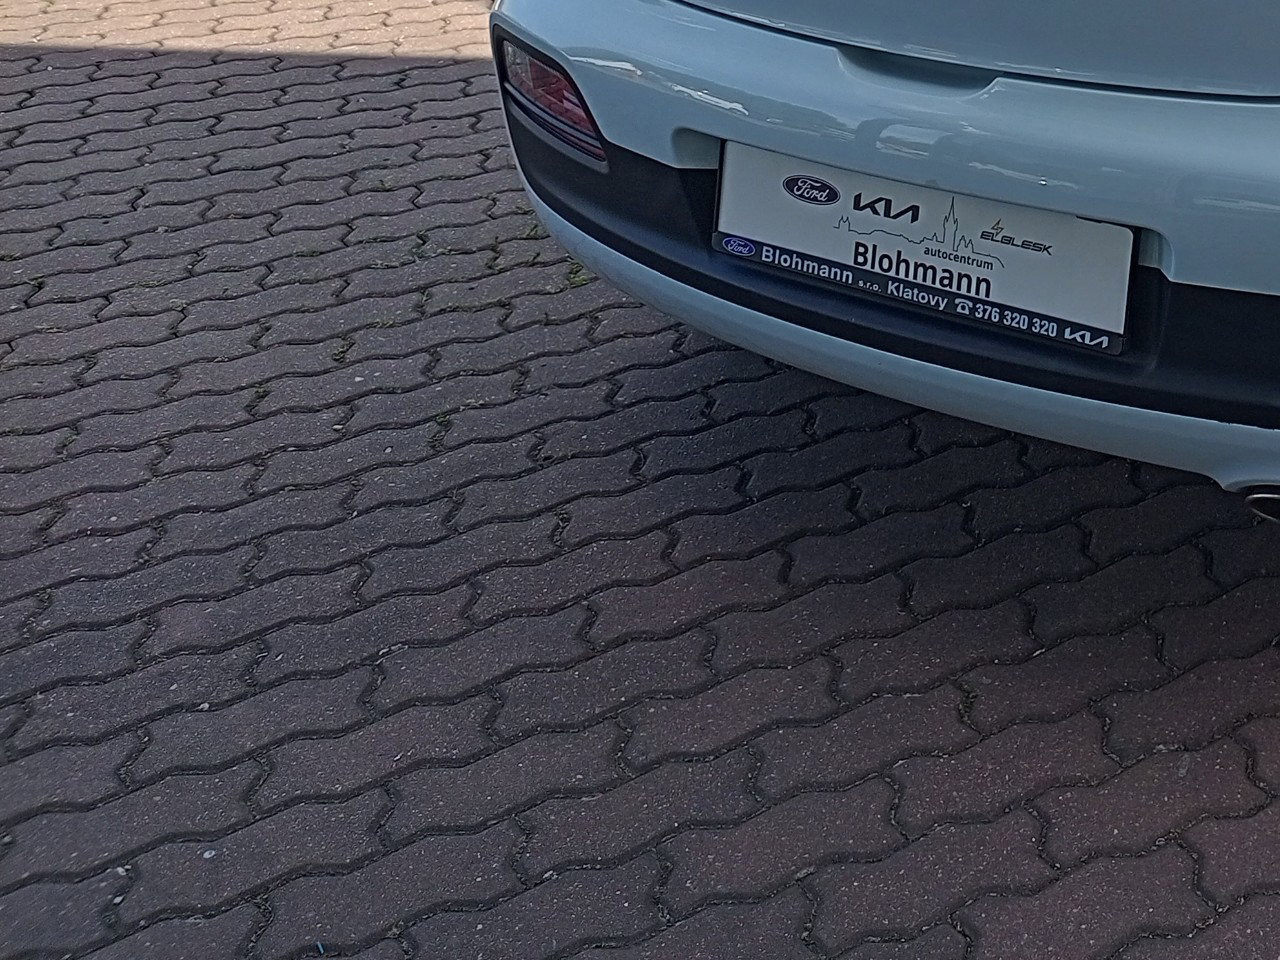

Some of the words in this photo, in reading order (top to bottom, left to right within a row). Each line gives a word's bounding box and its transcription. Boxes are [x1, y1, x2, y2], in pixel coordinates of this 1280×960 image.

[793, 178, 830, 202] Ford
[853, 192, 919, 224] KIA
[924, 245, 994, 271] autocentrum
[980, 229, 1053, 256] ELBLESK
[761, 246, 853, 284] Blohmann
[858, 280, 882, 292] s.r.o.
[887, 280, 948, 311] Klatovy
[975, 303, 1000, 323] 376
[1003, 310, 1028, 330] 320
[1032, 317, 1058, 338] 320
[853, 241, 992, 299] Blohmann
